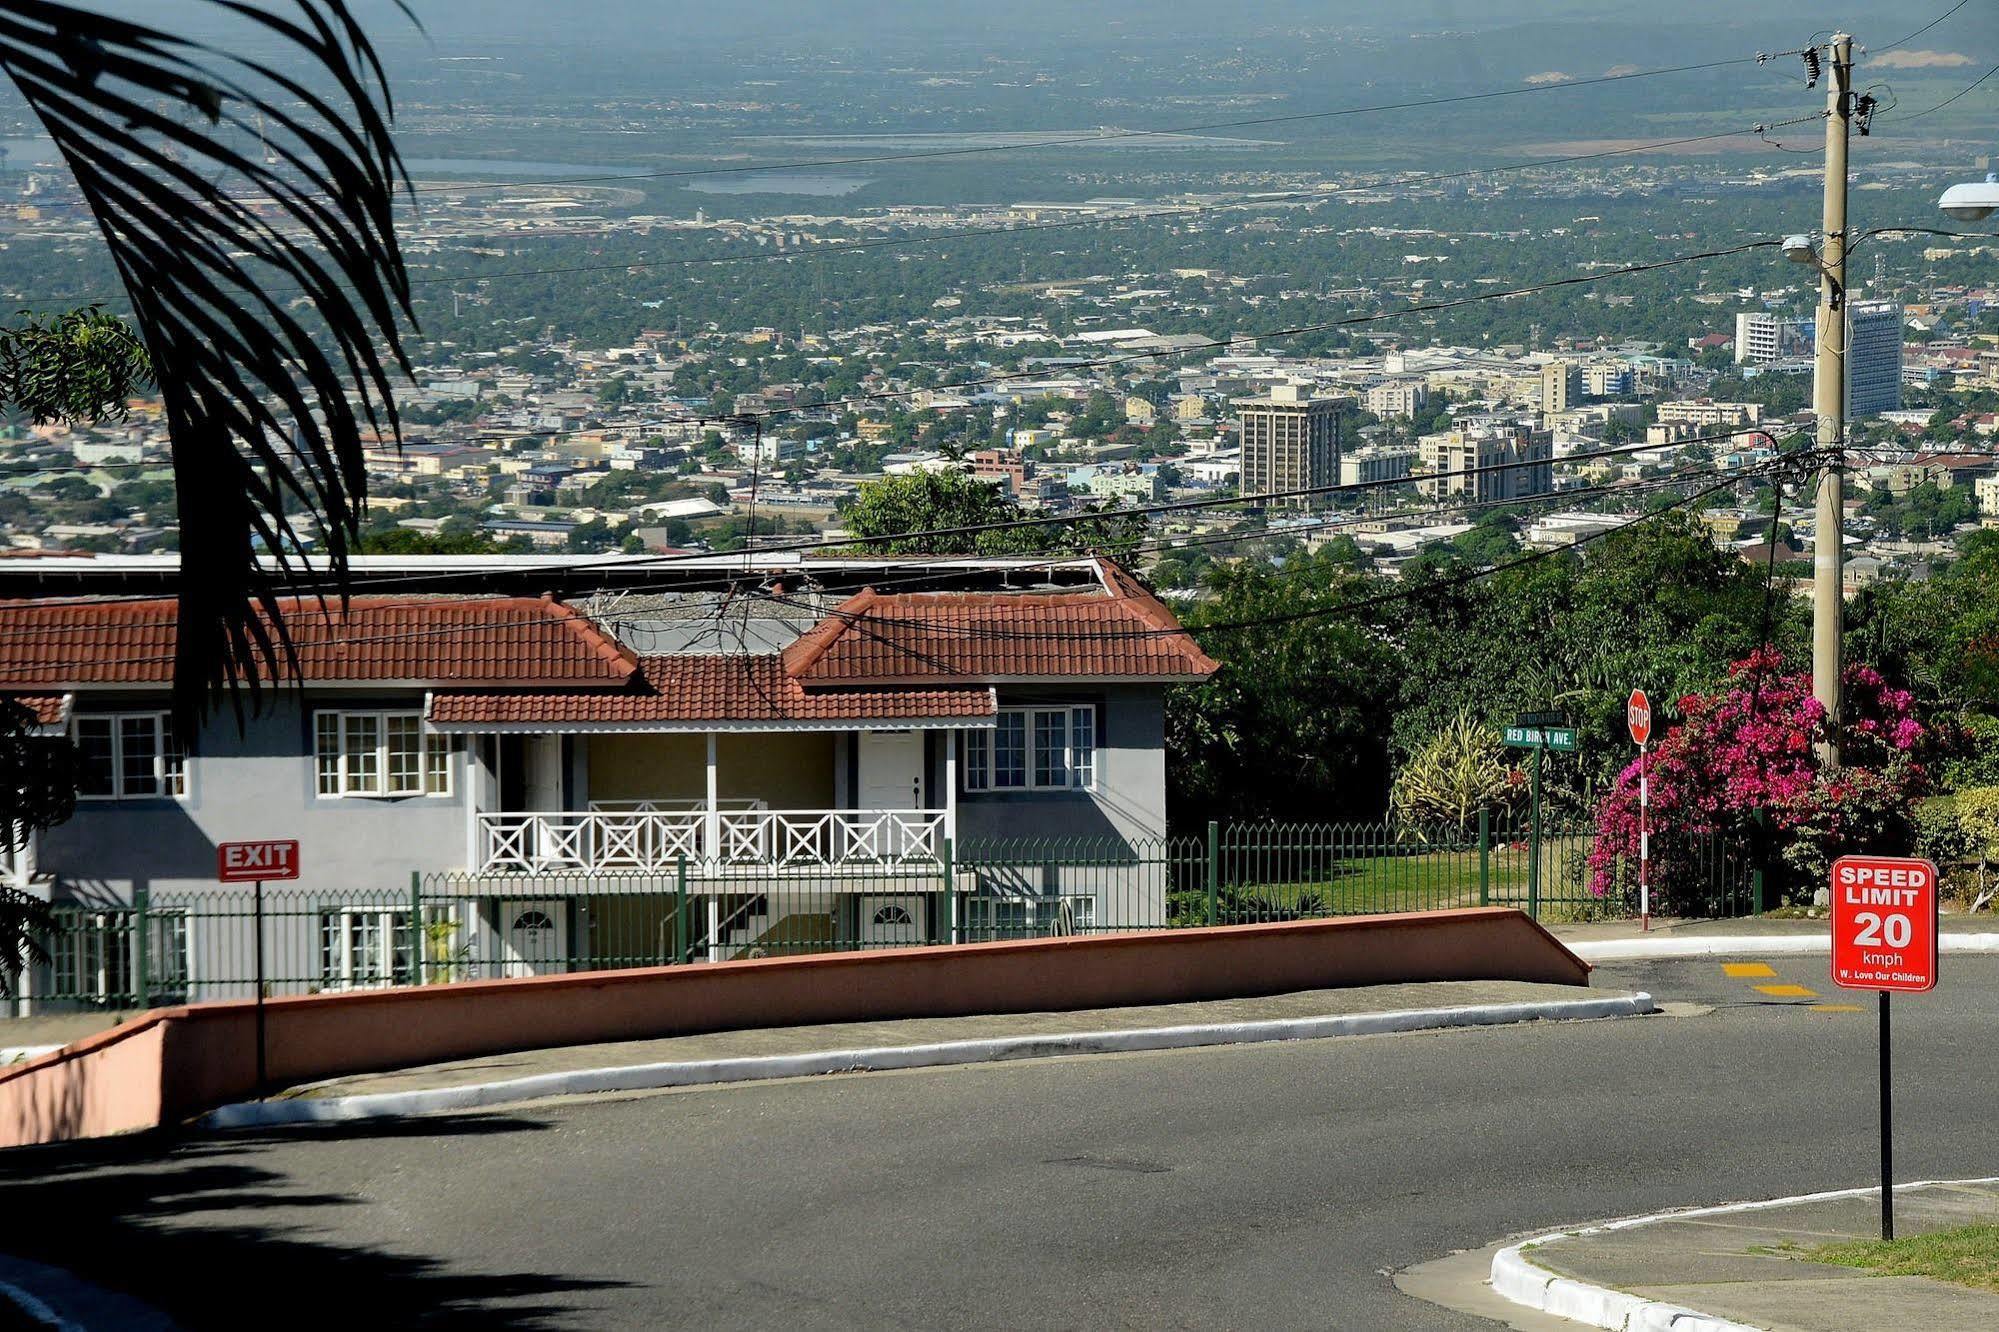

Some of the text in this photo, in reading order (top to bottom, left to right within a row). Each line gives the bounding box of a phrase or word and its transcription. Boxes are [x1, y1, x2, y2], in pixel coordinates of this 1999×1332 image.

[1630, 705, 1649, 728] STOP
[1507, 729, 1523, 742] RED
[1553, 732, 1572, 745] AVE.
[225, 844, 292, 868] EXIT
[1839, 867, 1926, 887] SPEED
[1846, 886, 1919, 907] LIMIT
[1853, 911, 1912, 948] 20
[1863, 950, 1903, 968] kmph
[1840, 969, 1926, 983] W Love Our Children
